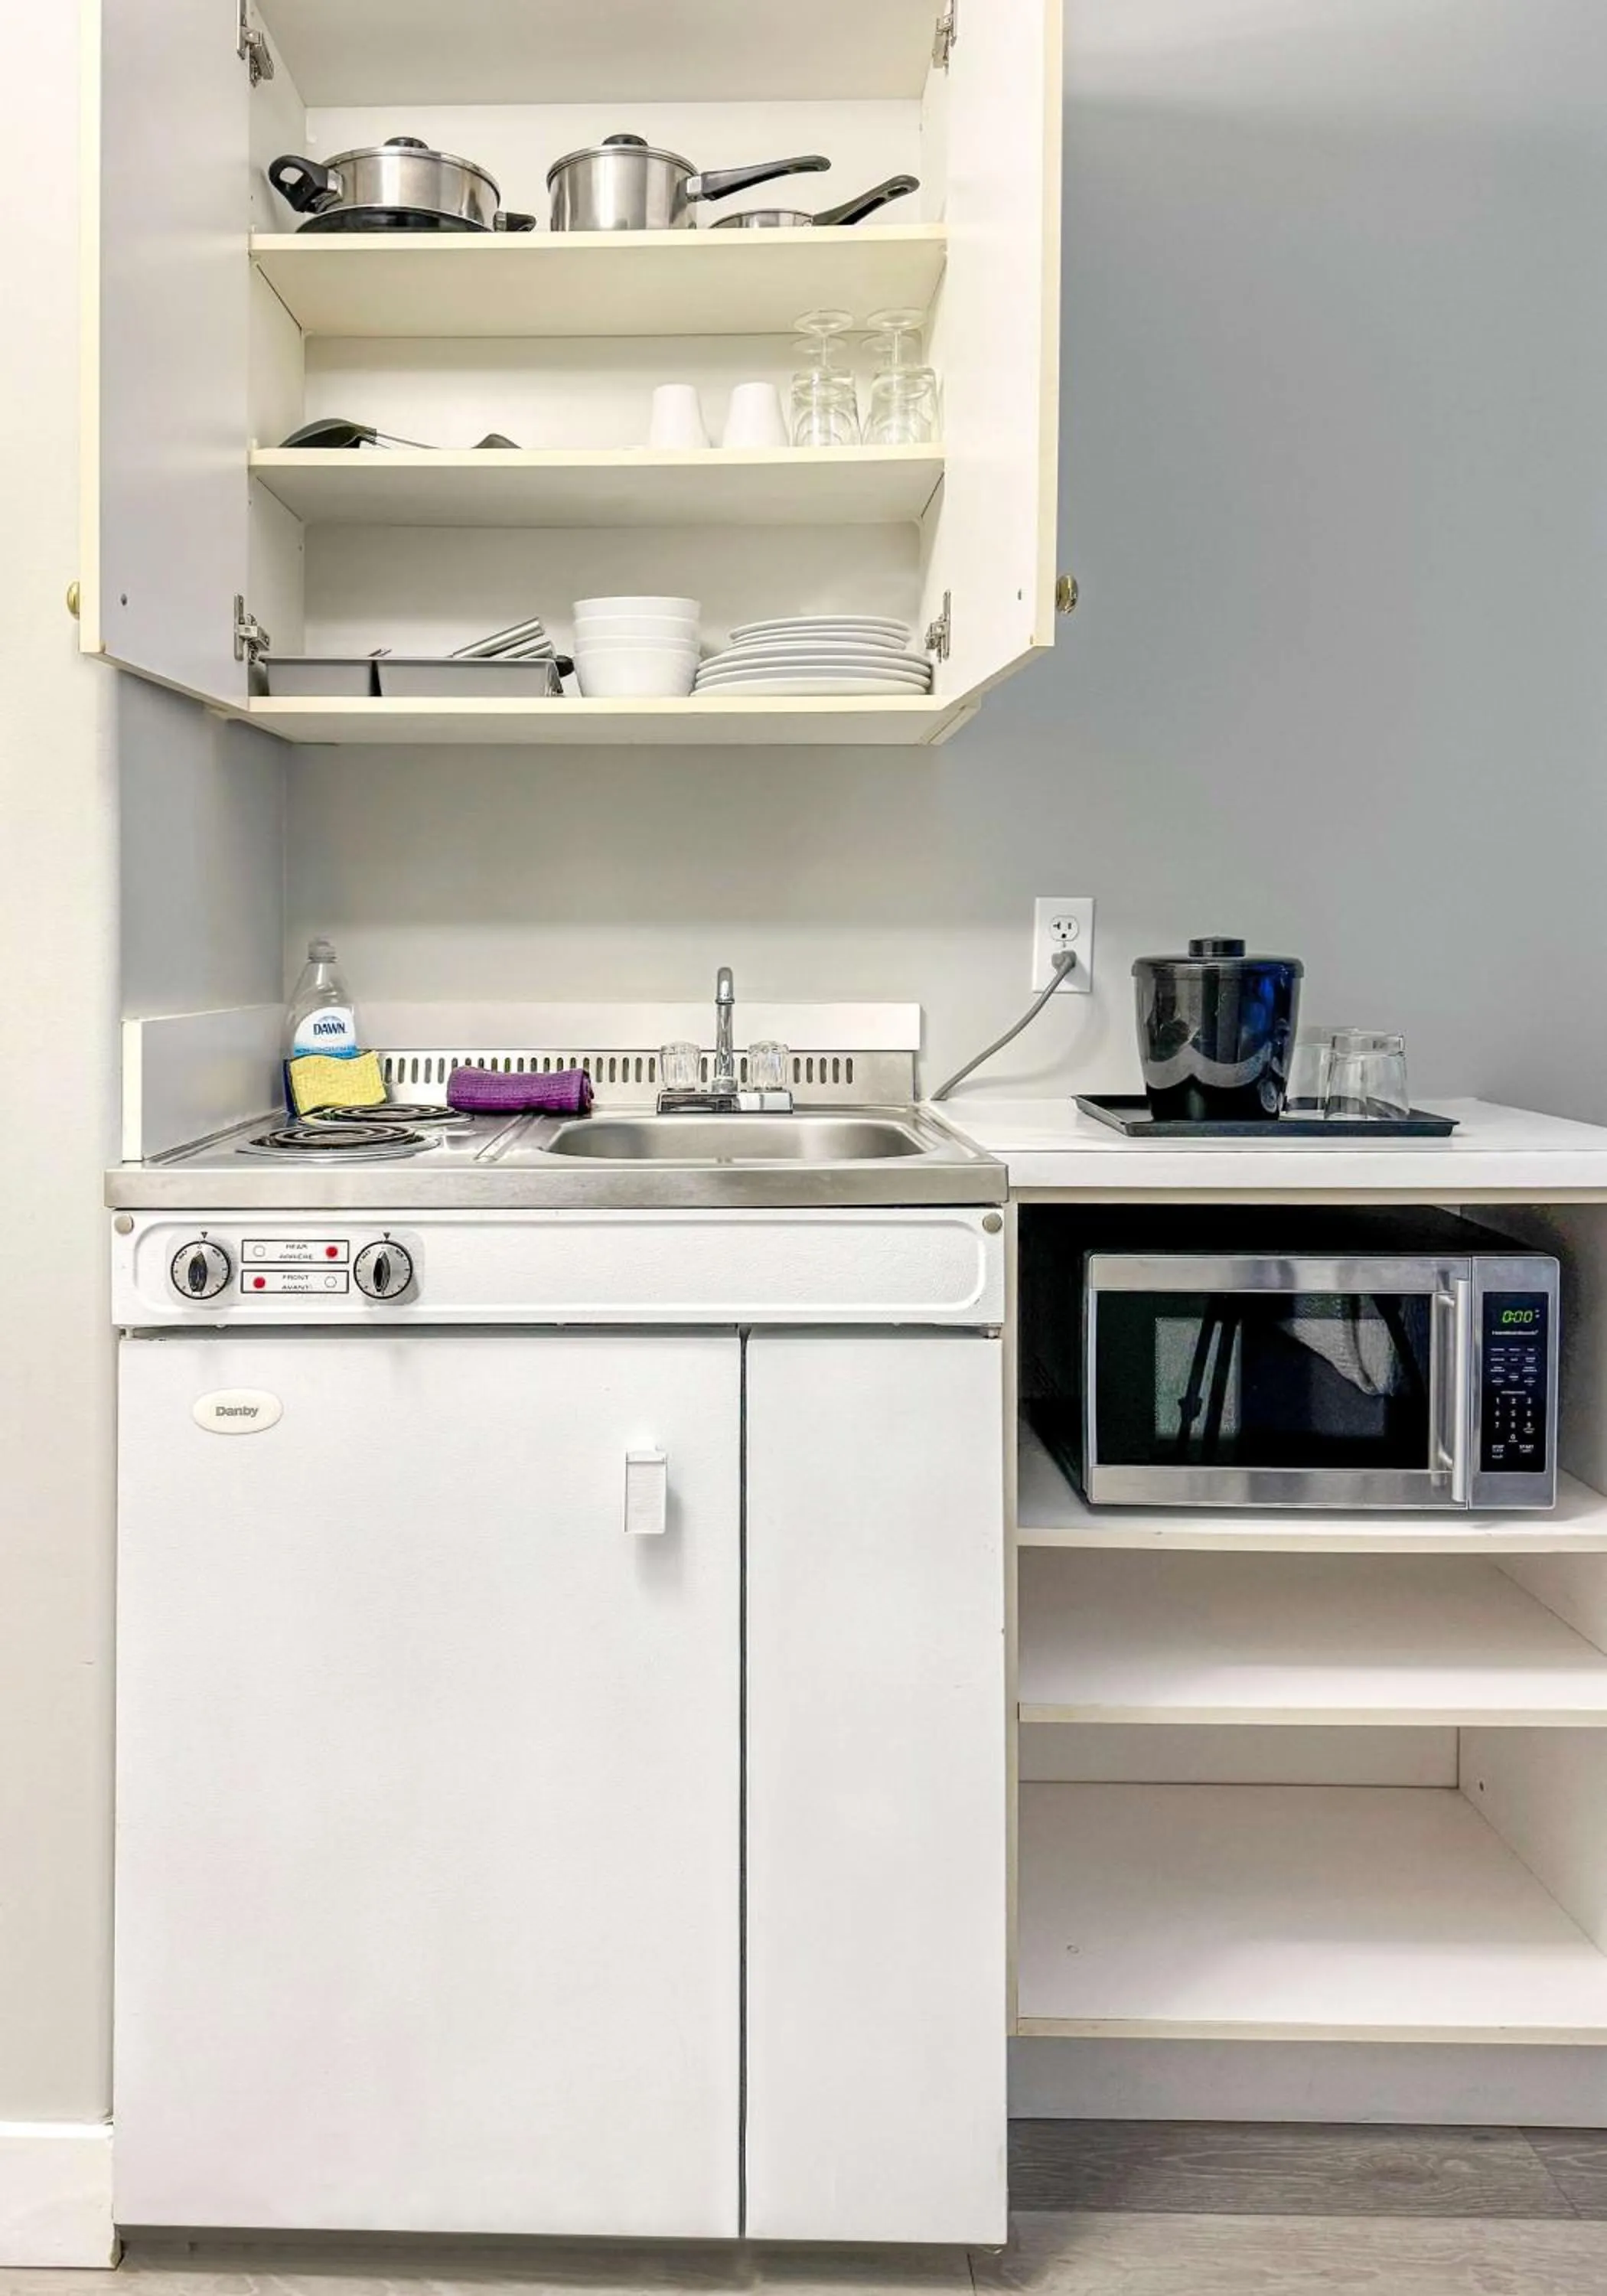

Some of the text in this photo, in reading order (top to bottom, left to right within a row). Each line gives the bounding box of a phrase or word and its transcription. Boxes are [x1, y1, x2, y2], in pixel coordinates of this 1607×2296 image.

[313, 1022, 346, 1035] DAWN
[1502, 1310, 1533, 1322] 0:00
[215, 1406, 259, 1417] Danby
